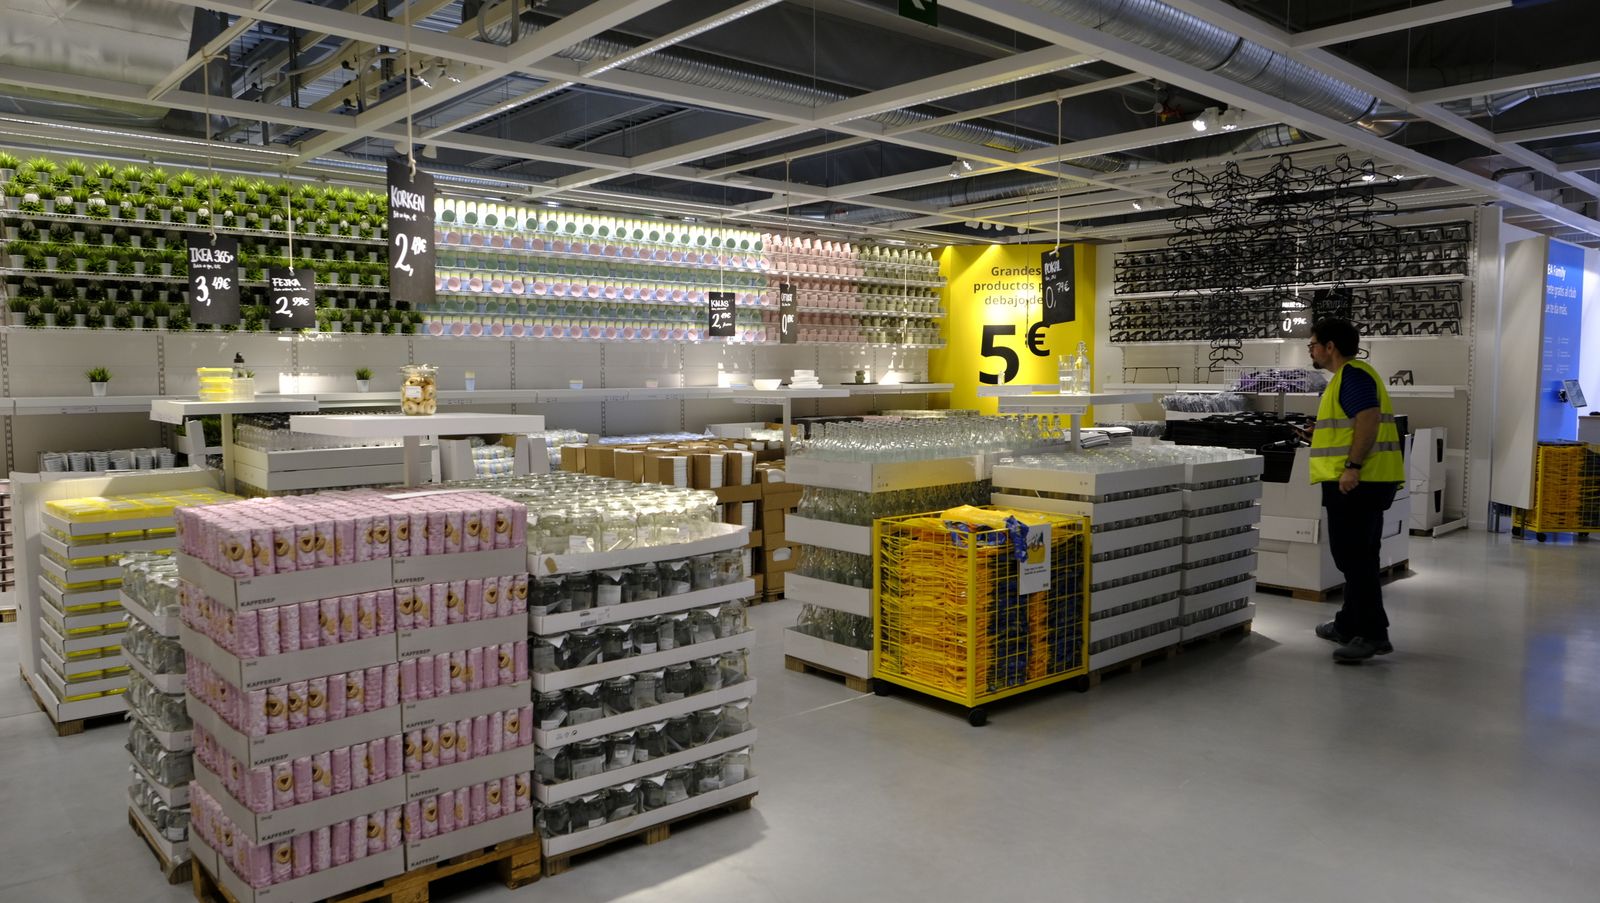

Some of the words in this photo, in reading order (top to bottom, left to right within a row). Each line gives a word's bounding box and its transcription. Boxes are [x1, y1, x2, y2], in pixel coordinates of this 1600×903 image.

[390, 185, 425, 213] KORKEN
[189, 247, 213, 263] IKEA
[991, 266, 1042, 276] Grandes
[271, 277, 301, 287] FEJKA
[973, 280, 1035, 293] productos
[195, 275, 232, 306] 3,49€
[275, 296, 310, 318] 2,99€
[984, 296, 1026, 307] debajo
[1028, 295, 1043, 306] de
[241, 597, 276, 608] KAFFEREP
[246, 677, 282, 689] KAFFEREP
[254, 753, 289, 766] KAFFEREP
[262, 828, 295, 841] KAFFEREP
